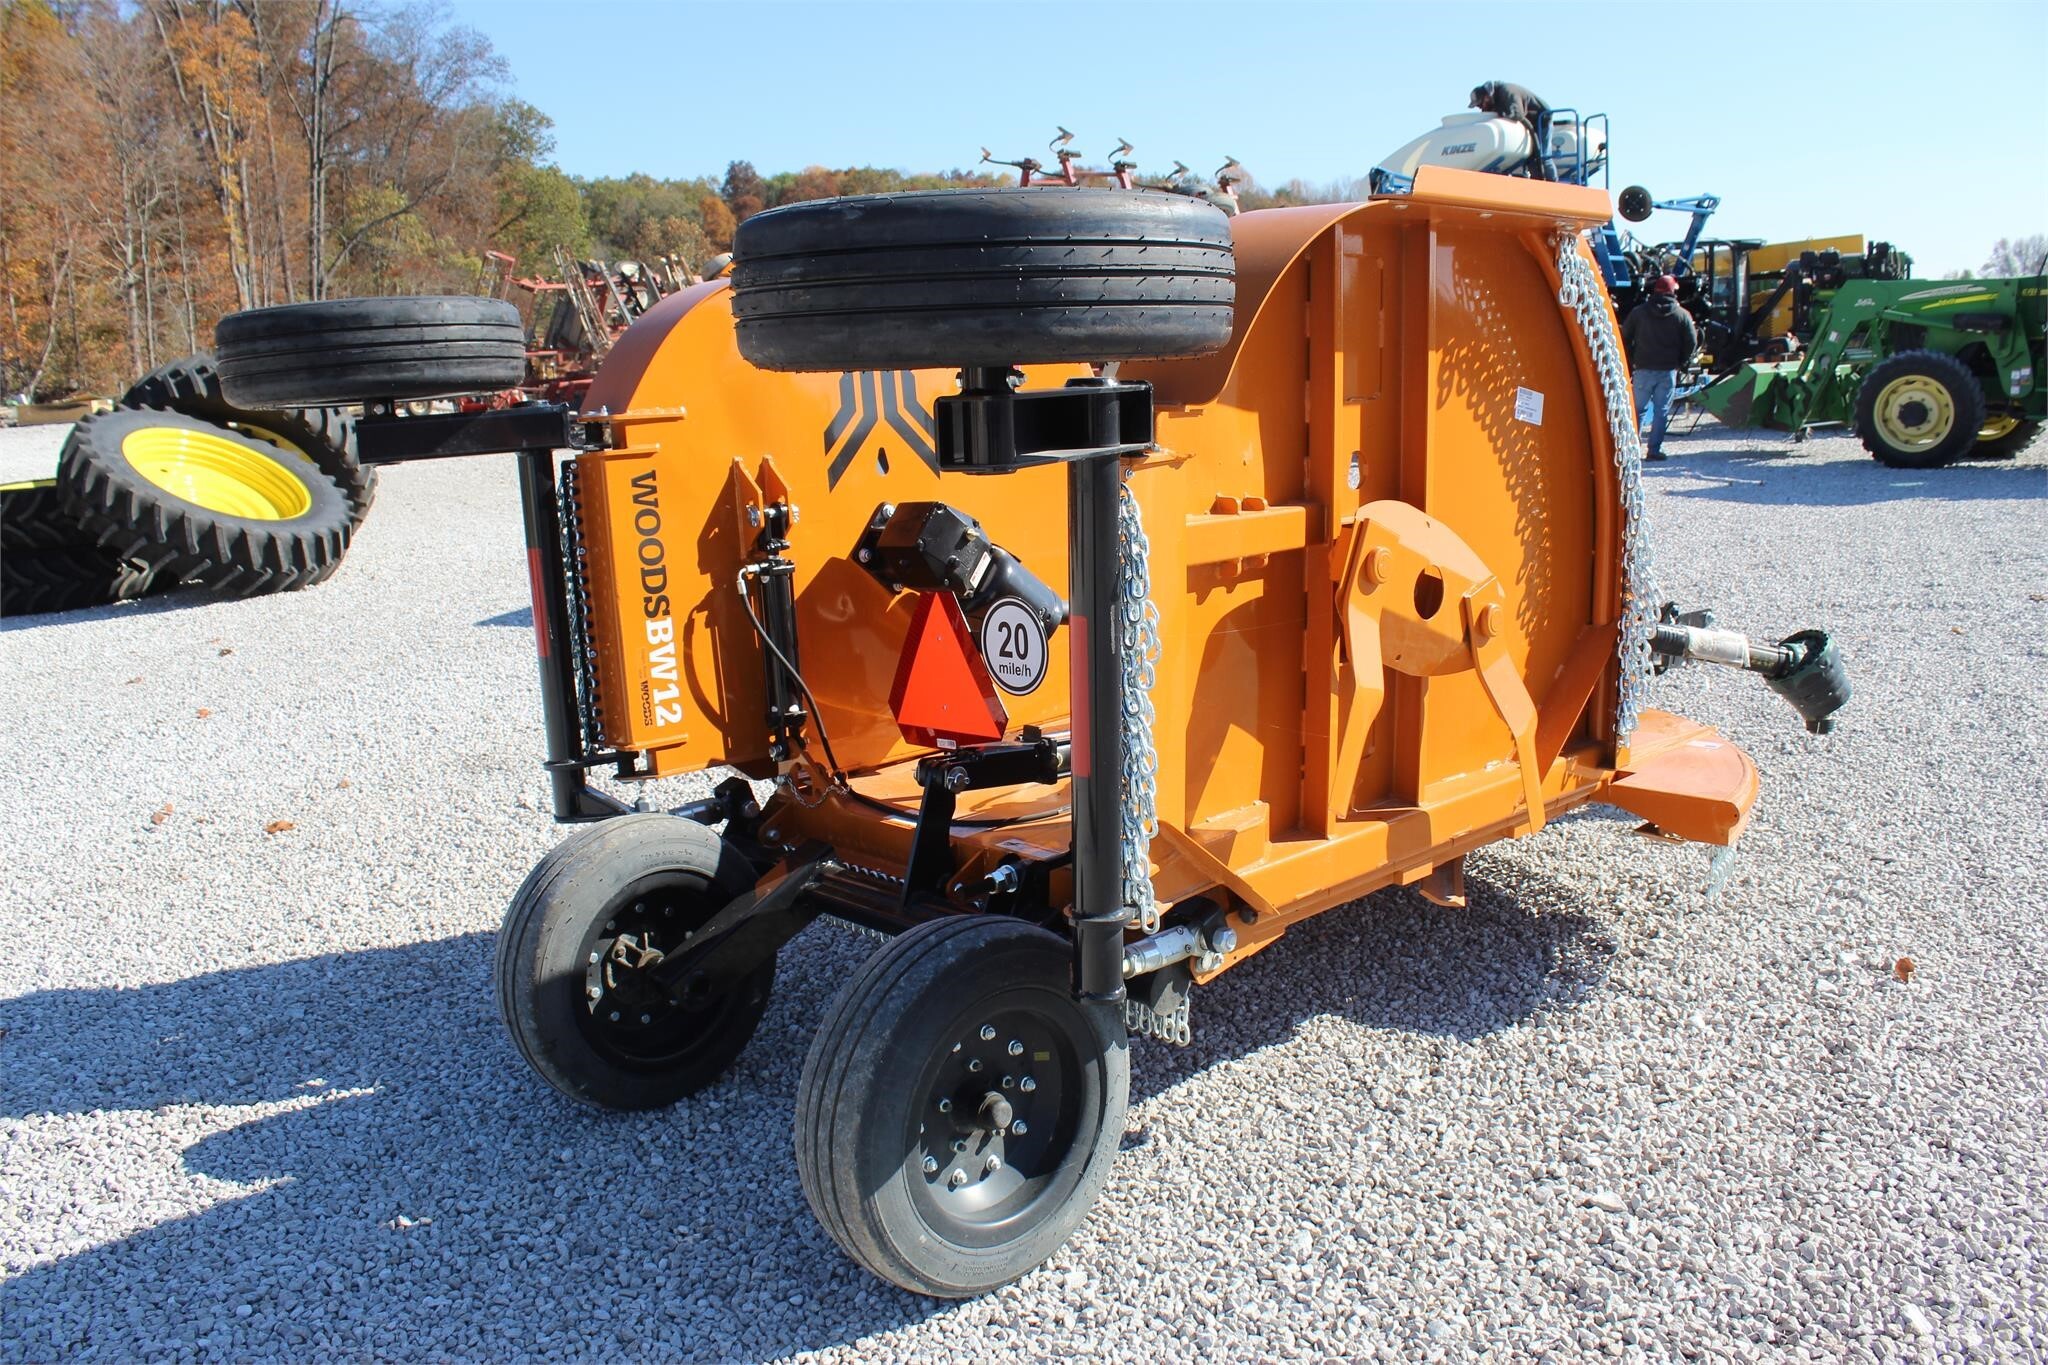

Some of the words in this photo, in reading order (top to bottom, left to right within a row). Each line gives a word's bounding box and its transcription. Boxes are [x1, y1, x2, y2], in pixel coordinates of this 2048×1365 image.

[1441, 142, 1477, 156] KINZE
[998, 621, 1029, 660] 20
[999, 662, 1032, 678] mile/h
[640, 680, 653, 727] WOODS
